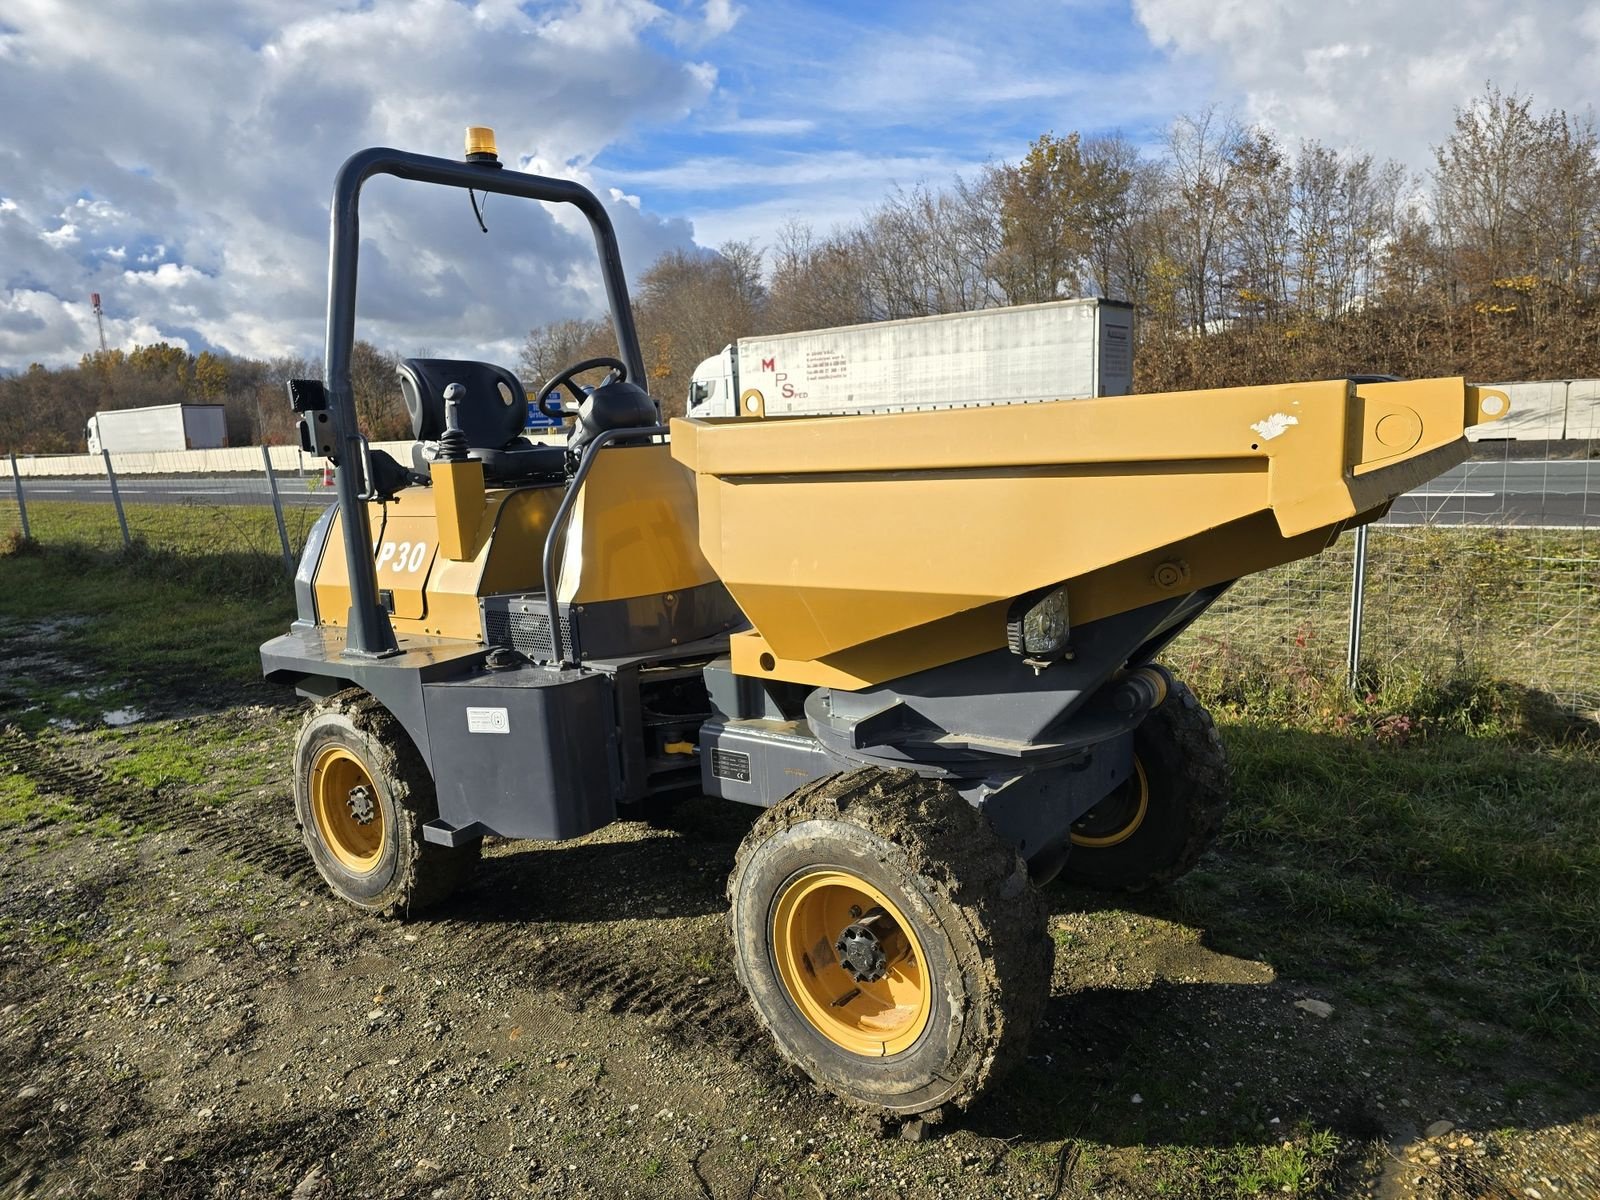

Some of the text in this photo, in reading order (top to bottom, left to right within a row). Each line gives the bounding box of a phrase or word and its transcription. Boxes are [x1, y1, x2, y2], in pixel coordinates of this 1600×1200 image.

[762, 358, 775, 372] M
[775, 373, 788, 387] P
[374, 541, 426, 572] P30
